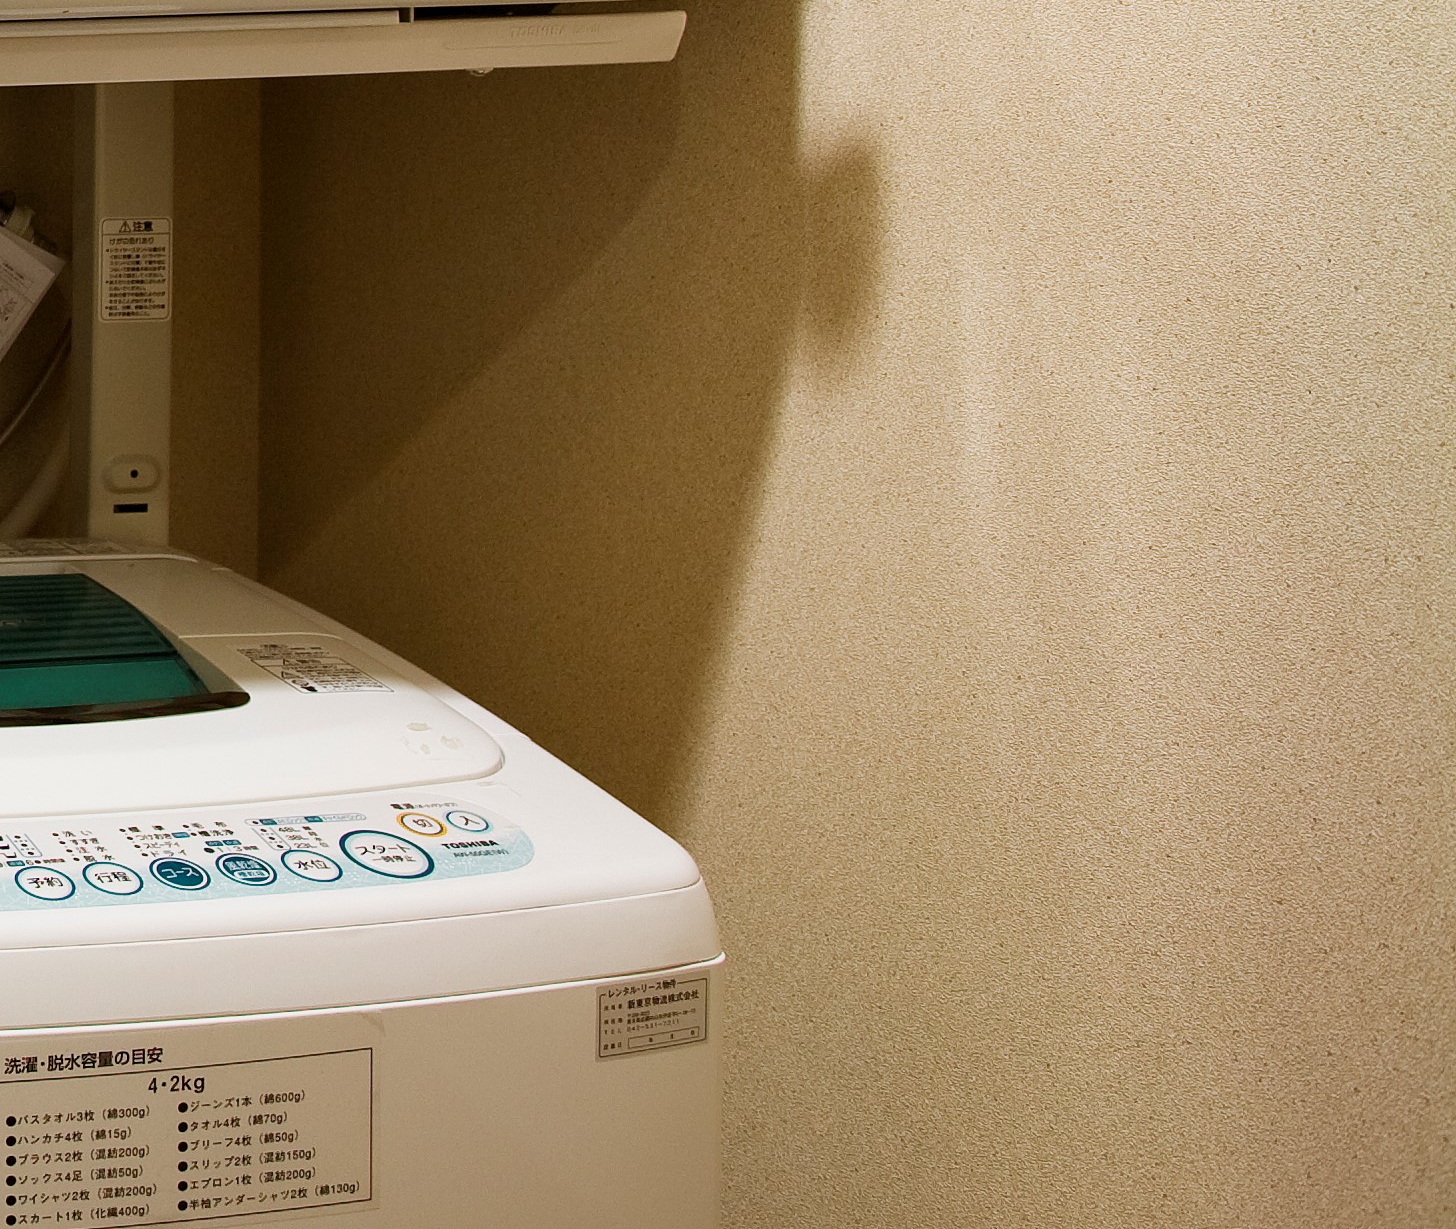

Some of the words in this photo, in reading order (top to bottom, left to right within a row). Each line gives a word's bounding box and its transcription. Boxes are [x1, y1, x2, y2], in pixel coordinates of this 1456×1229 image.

[355, 844, 412, 854] スタート
[442, 840, 500, 849] TOSHIBA
[294, 860, 330, 870] 水位
[95, 872, 132, 884] 行程
[162, 868, 199, 878] コース
[4, 1047, 163, 1075] 洗濯・脱水容量の目安
